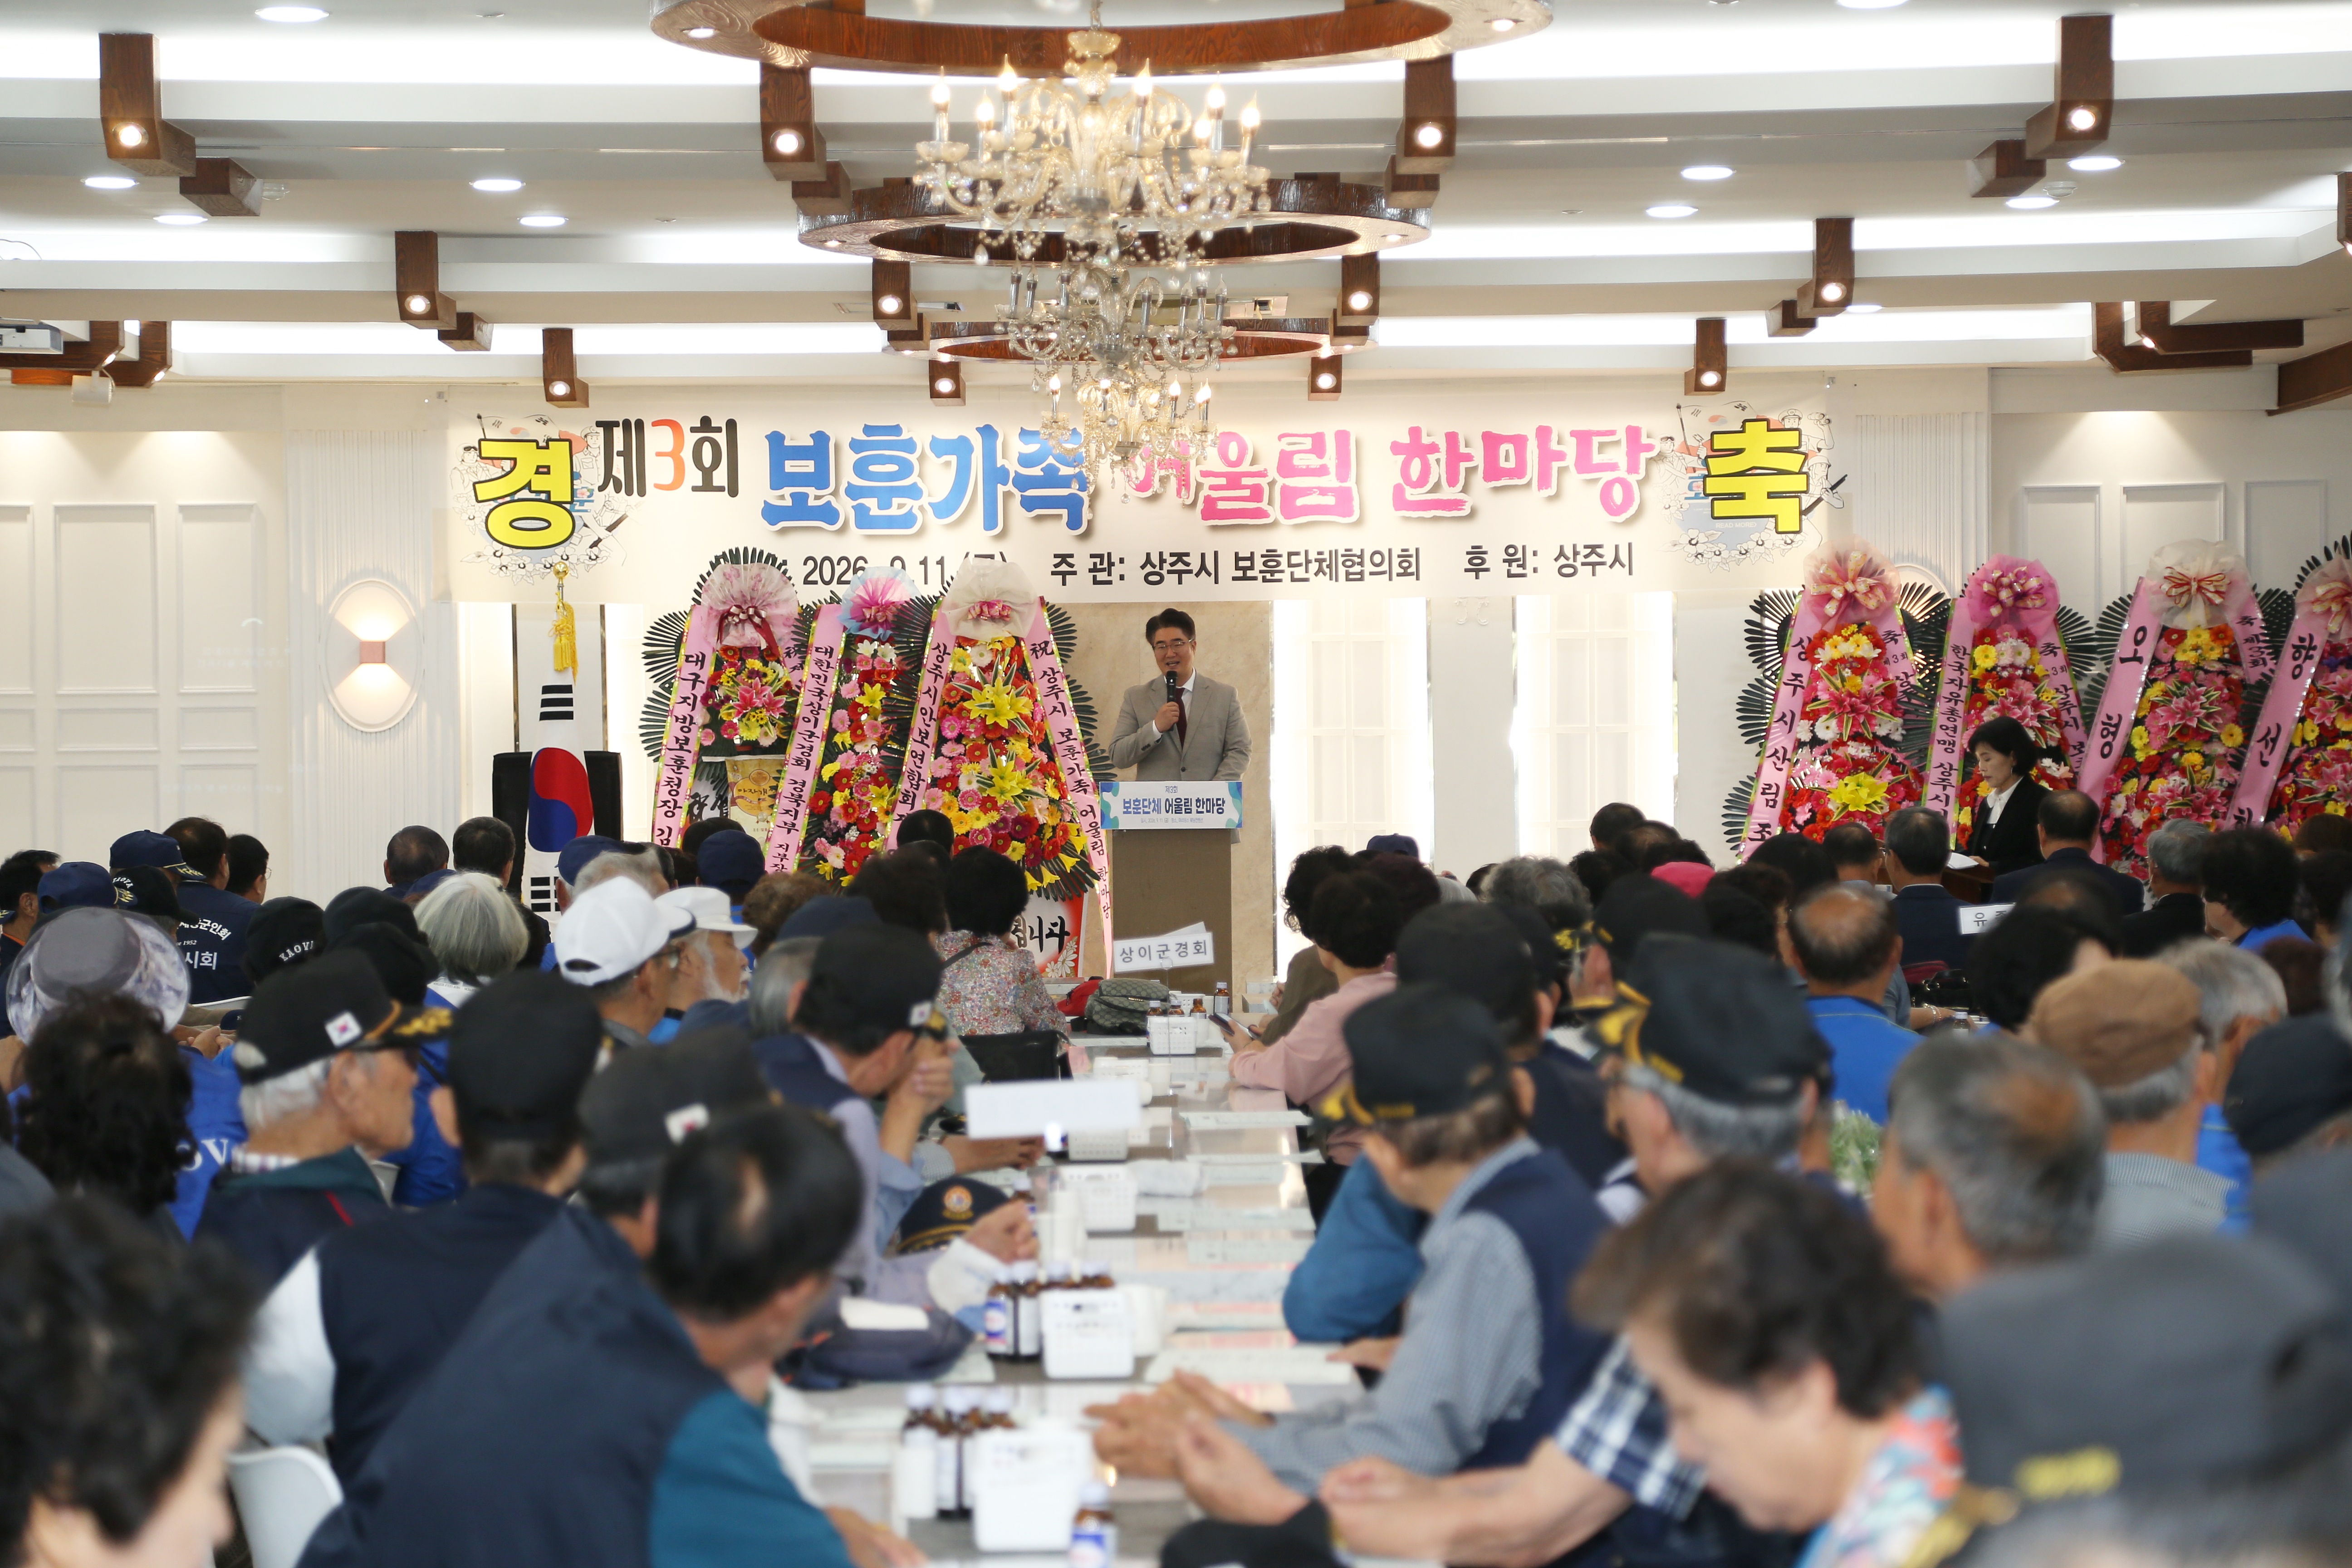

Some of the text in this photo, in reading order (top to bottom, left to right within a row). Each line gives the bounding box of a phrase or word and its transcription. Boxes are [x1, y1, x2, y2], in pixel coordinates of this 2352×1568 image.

[473, 438, 575, 550] 경
[595, 416, 739, 498] 제3회
[761, 424, 1088, 531] 보훈가족
[1389, 425, 1655, 517] 한마당
[1703, 419, 1810, 534] 축
[1140, 550, 1219, 586] 상주시
[1232, 548, 1421, 583] 보훈단체협의회
[1553, 543, 1633, 578] 상주시
[1882, 629, 1902, 645] 축
[2040, 642, 2062, 657] 축
[656, 651, 706, 818] 대구지방보훈청장
[790, 645, 834, 771] 대한민국상이군경회
[898, 642, 951, 811] 상주시안보연합회
[1936, 643, 1971, 754] 한국자유총연맹
[776, 779, 806, 835] 경북지부
[1030, 640, 1111, 919] 祝 상주시 보훈가족 어울림 한마당
[1122, 797, 1225, 815] 보훈단체 어울림 한마당
[1165, 785, 1178, 794] 제3회
[1119, 939, 1208, 963] 상이군경회
